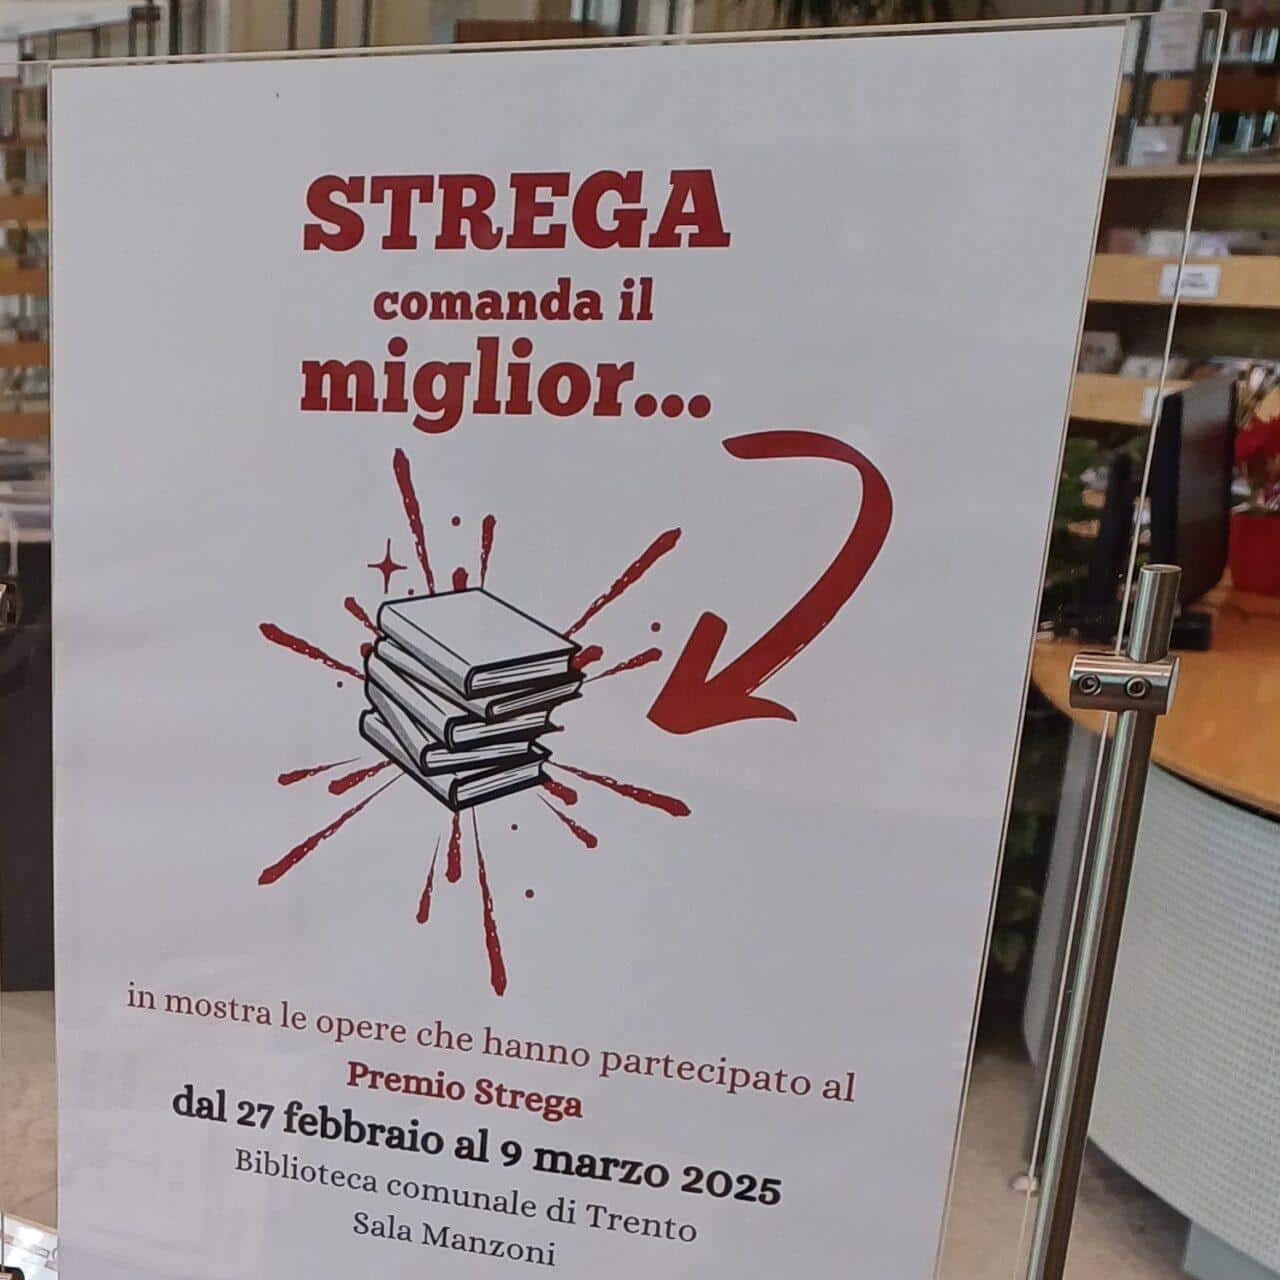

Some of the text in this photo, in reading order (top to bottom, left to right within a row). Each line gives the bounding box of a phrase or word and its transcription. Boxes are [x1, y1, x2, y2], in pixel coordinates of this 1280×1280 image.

[303, 169, 731, 252] STREGA
[373, 277, 654, 320] comanda il
[300, 336, 712, 434] miglior...
[127, 981, 856, 1102] in mostra le opere che hanno partecipato al
[346, 1060, 583, 1122] Premio Strega
[172, 1083, 783, 1206] dal 27 febbraio al 9 marzo 2025
[233, 1148, 698, 1243] Biblioteca comunale di Trento
[352, 1211, 556, 1267] Sala Manzoni
